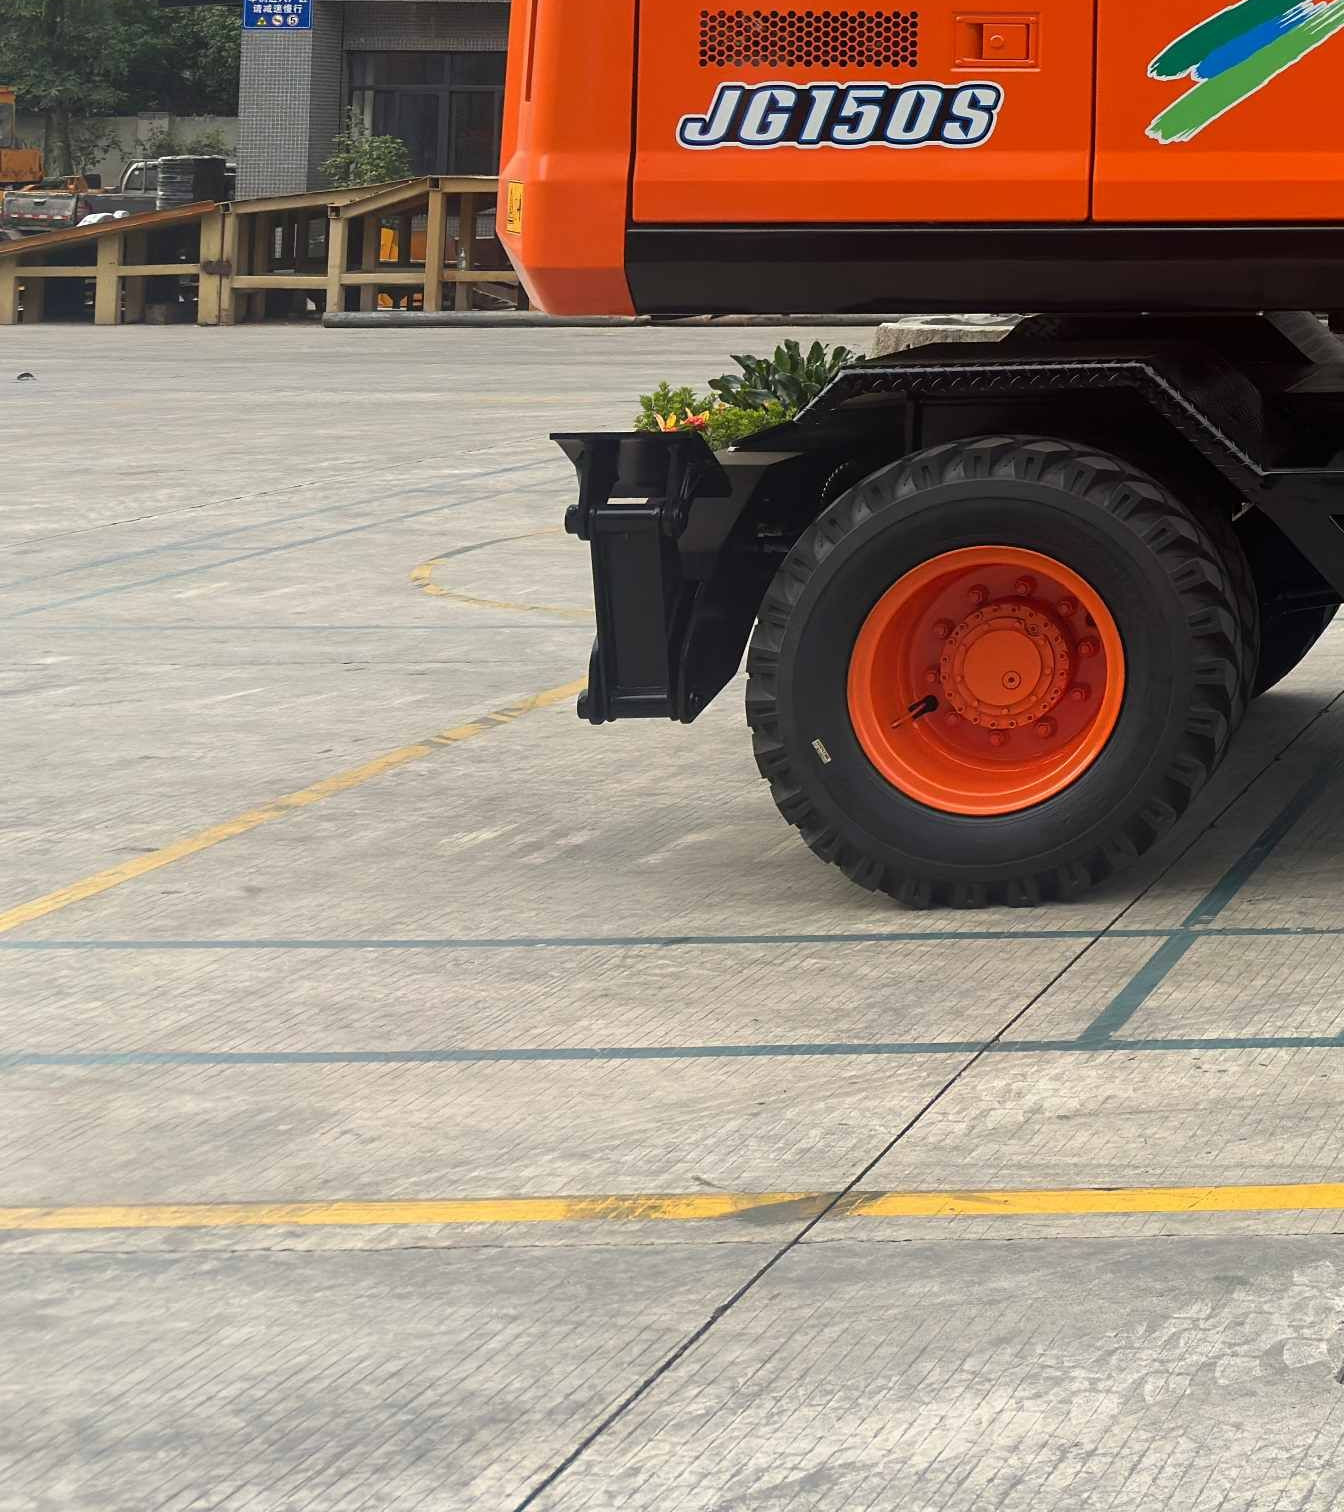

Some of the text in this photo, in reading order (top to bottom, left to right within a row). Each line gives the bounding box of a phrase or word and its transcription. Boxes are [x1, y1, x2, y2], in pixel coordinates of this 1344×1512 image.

[253, 4, 303, 14] 请减速慢行
[682, 88, 998, 143] JG150S
